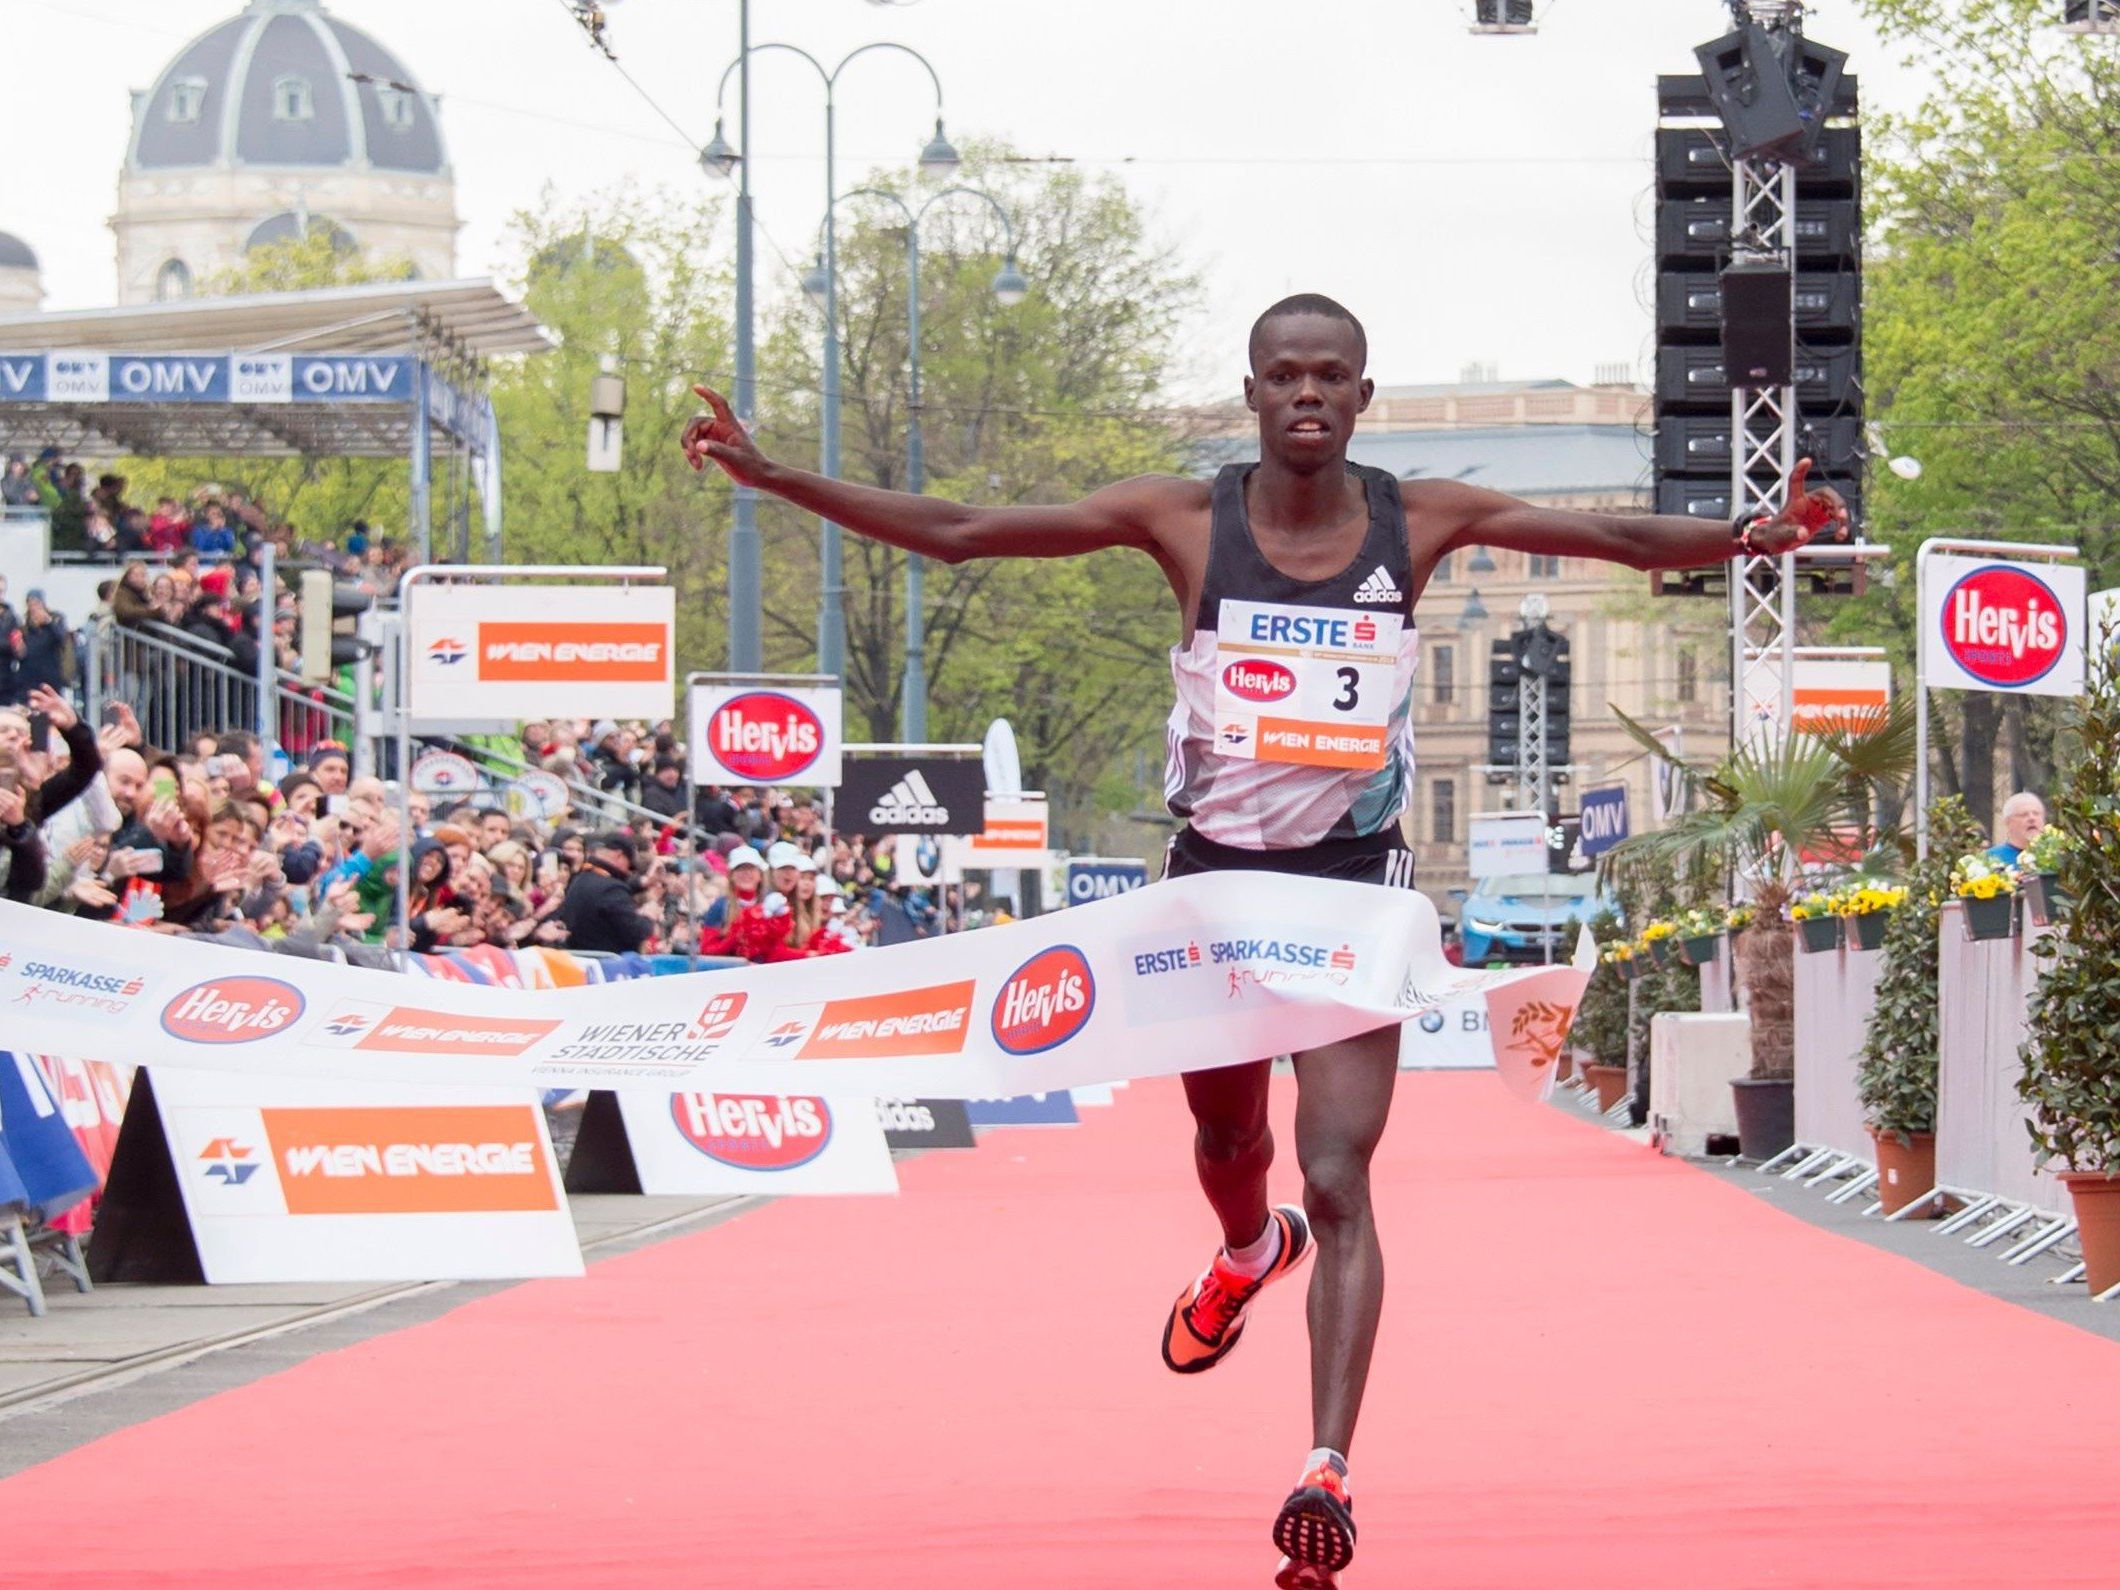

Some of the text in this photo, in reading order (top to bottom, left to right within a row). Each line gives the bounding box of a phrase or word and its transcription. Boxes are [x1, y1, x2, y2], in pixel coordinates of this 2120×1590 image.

[120, 361, 217, 393] OMV
[303, 361, 398, 393] OMV
[1353, 589, 1403, 604] adidas
[1251, 614, 1348, 647] ERSTE
[1955, 588, 2059, 659] Hervis
[487, 642, 661, 663] WIEN ENERGIE
[1230, 666, 1292, 695] Hervis
[1332, 666, 1360, 712] 3
[719, 709, 819, 761] Hervis
[1263, 730, 1381, 755] WIEN ENERGIE
[868, 805, 950, 826] adidas
[1582, 800, 1624, 842] OMV
[1071, 873, 1143, 900] OMV
[1135, 939, 1328, 976] ERSTE SPARKASSE
[20, 961, 125, 994] SPARKASSE
[174, 987, 291, 1032] Hervis
[1001, 968, 1085, 1029] Hervis
[378, 1024, 543, 1045] WIEN ENERGIE
[577, 1023, 687, 1042] WIENER
[817, 1007, 966, 1040] WIEN ENERGIE
[550, 1041, 721, 1063] STÄDTISCHE
[683, 1092, 822, 1148] Hervis
[285, 1143, 535, 1177] WIEN ENERGIE
